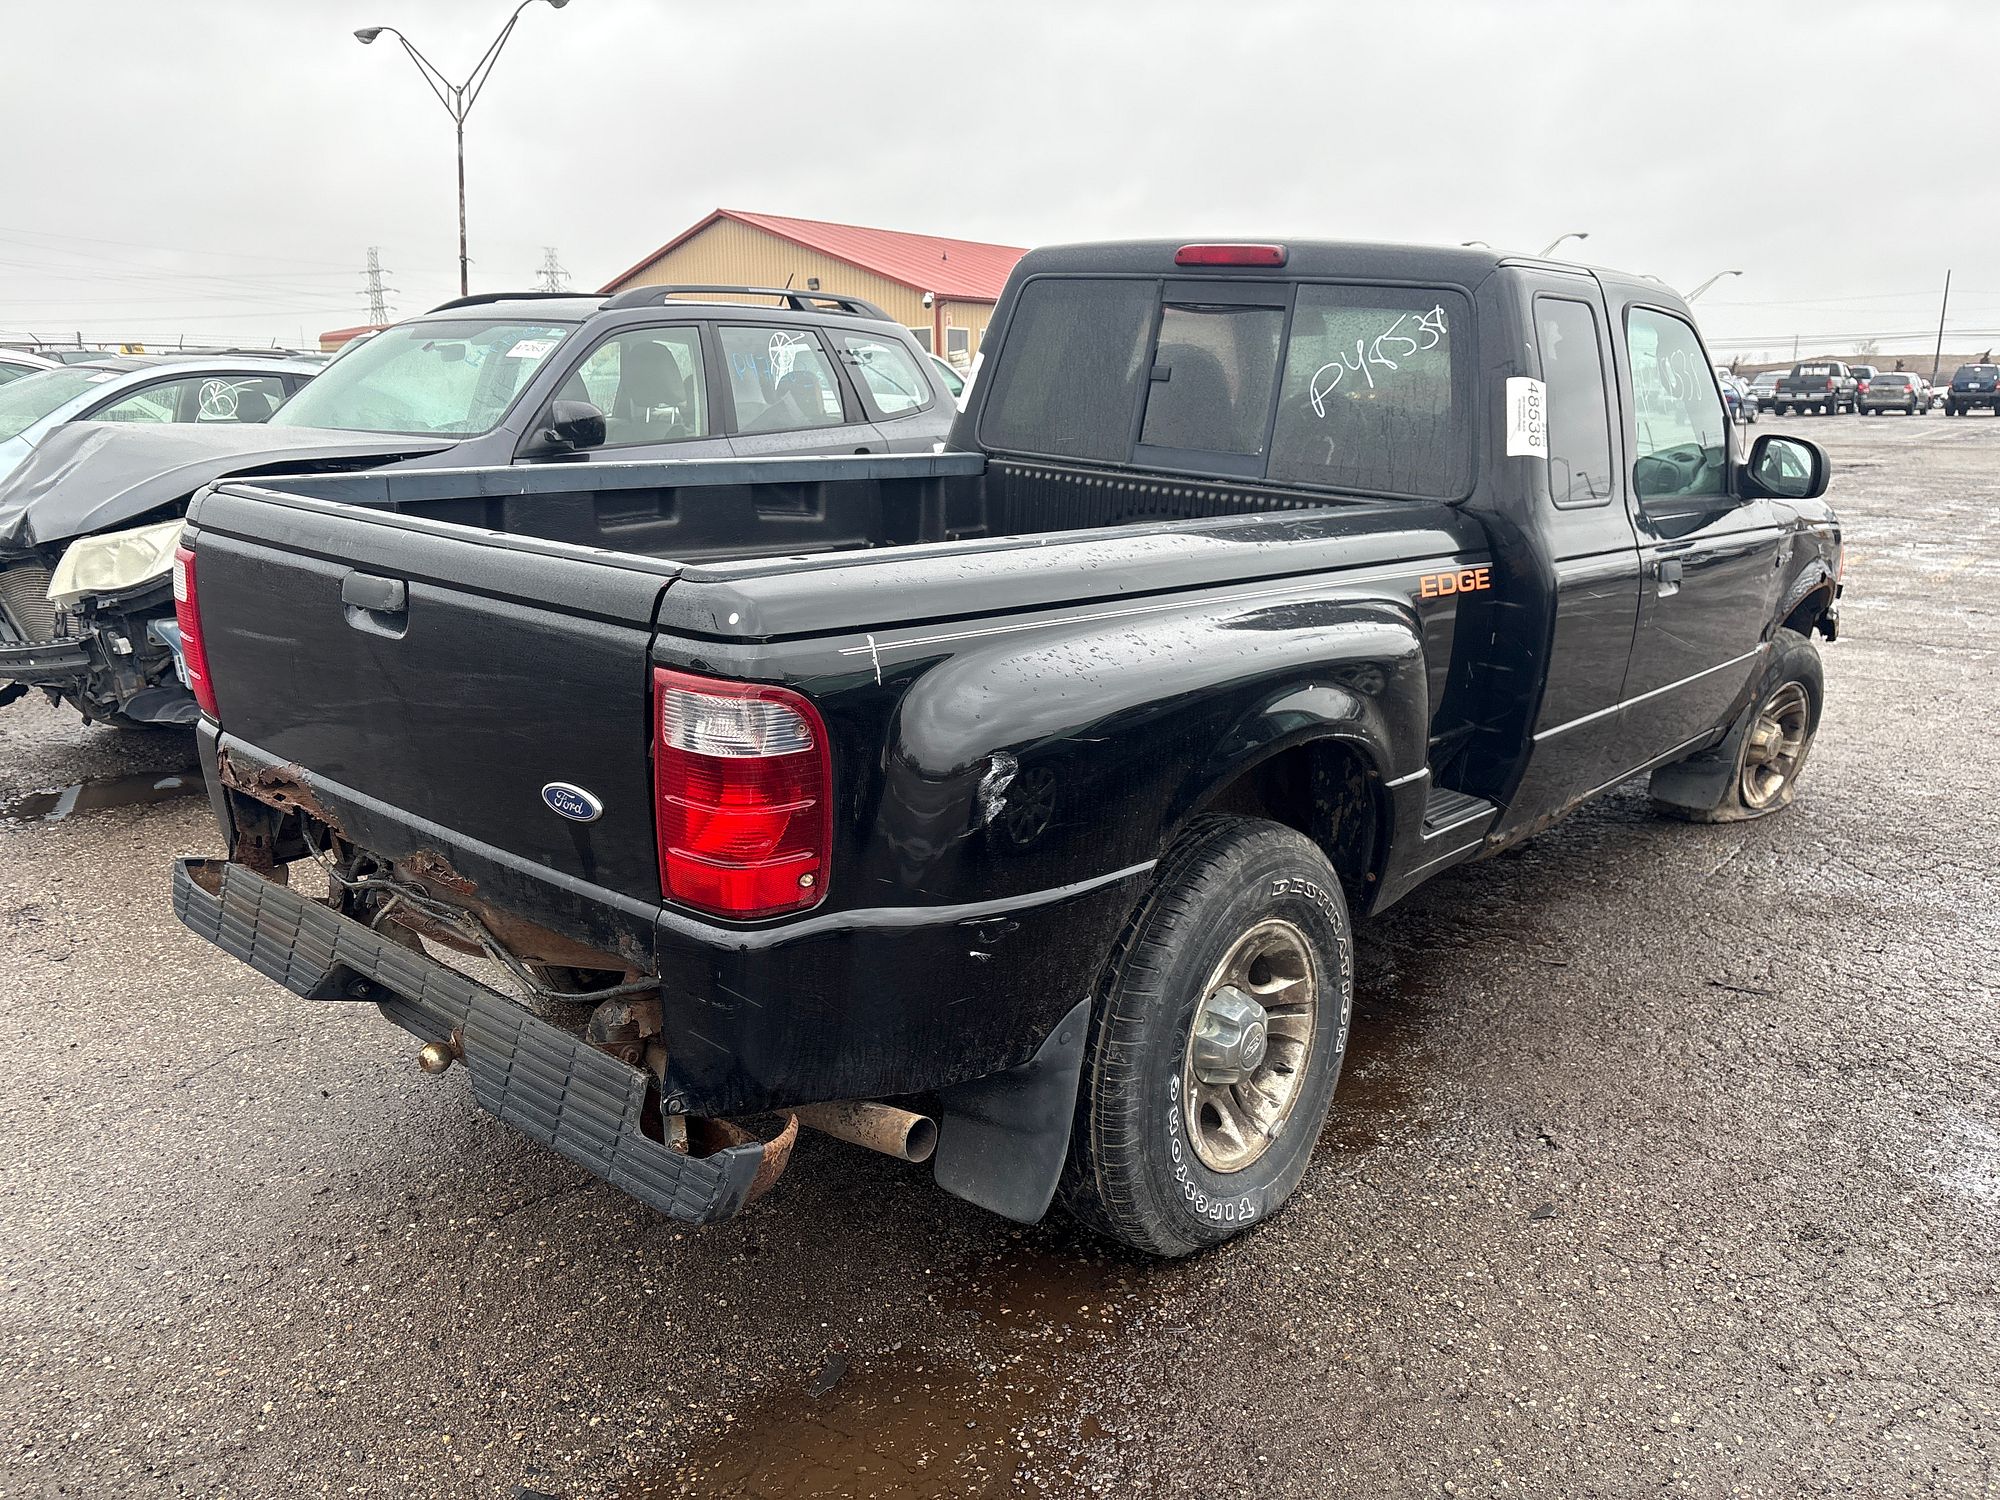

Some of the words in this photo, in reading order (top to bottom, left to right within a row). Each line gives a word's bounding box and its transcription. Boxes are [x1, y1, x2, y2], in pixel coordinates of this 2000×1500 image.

[1527, 381, 1541, 447] 48538
[1420, 568, 1490, 598] EDGE
[553, 790, 584, 815] Ford
[1271, 877, 1351, 1054] DESTINATION
